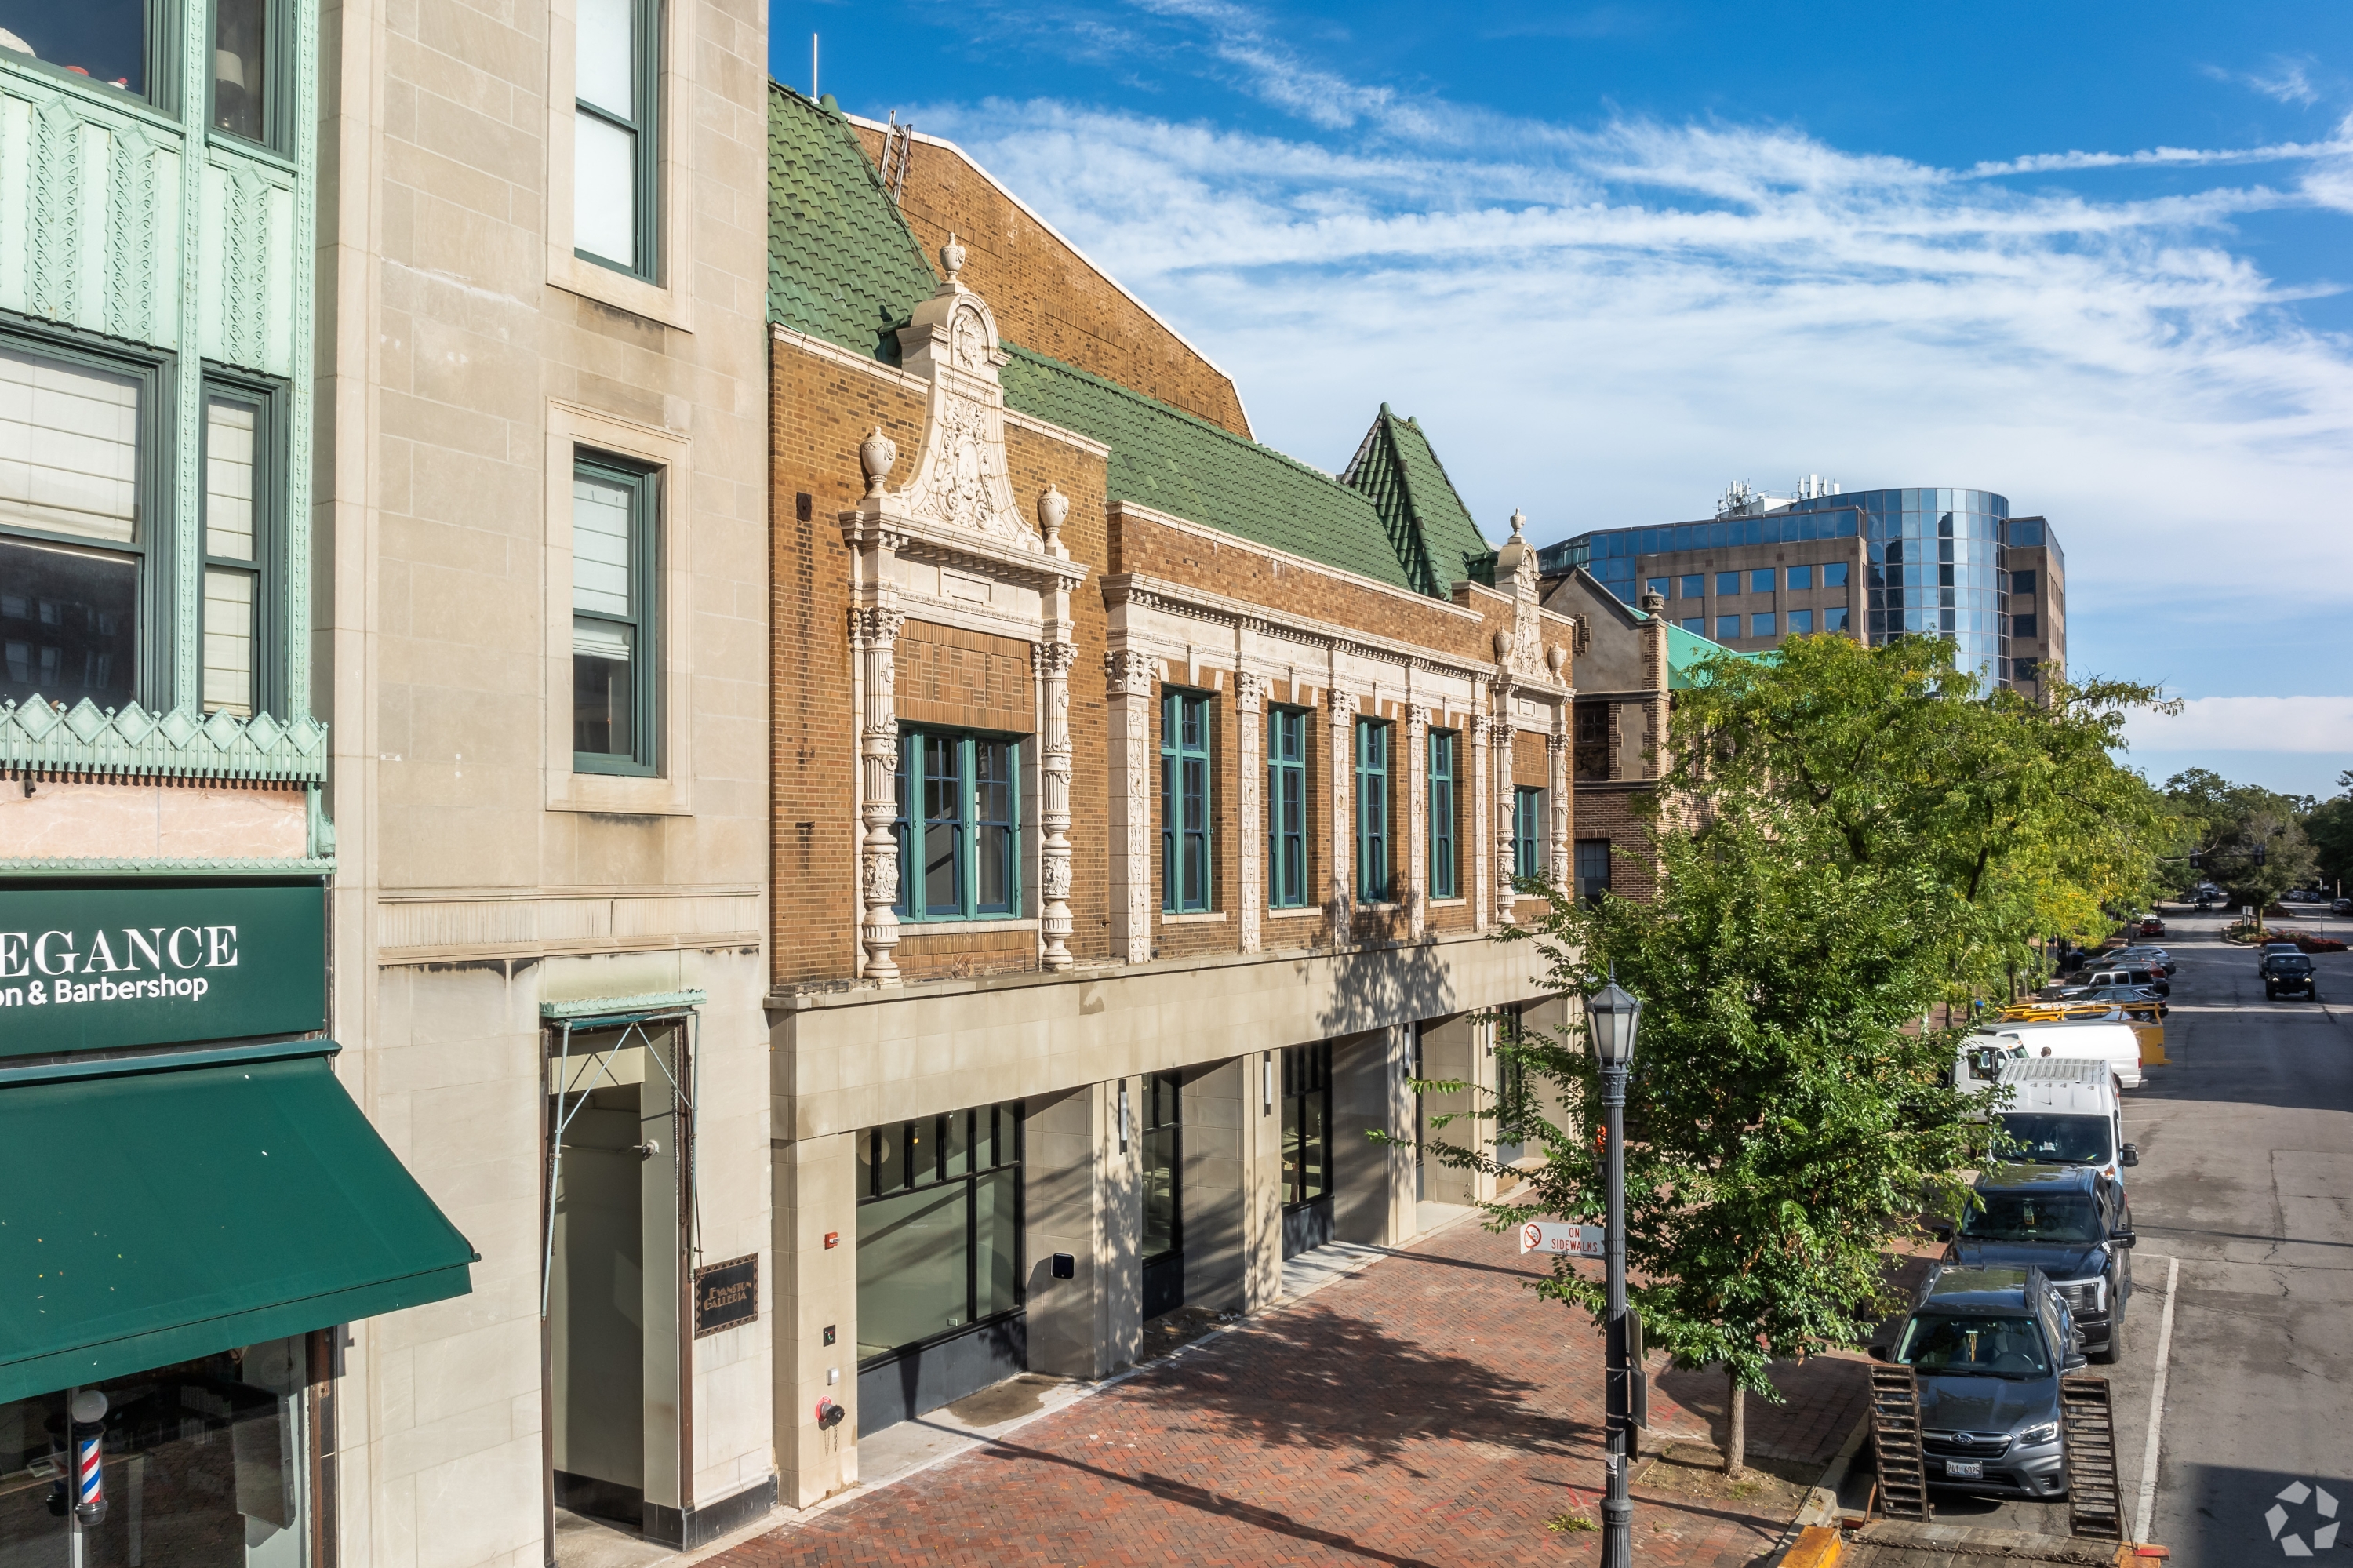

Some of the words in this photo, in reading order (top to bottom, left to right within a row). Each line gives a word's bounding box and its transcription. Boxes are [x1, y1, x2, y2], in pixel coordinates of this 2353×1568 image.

[0, 926, 238, 977] EGANCE
[27, 980, 48, 1006] &
[55, 973, 208, 1003] Barbershop
[1569, 1228, 1580, 1238] ON
[1551, 1239, 1598, 1252] SIDEWALKS
